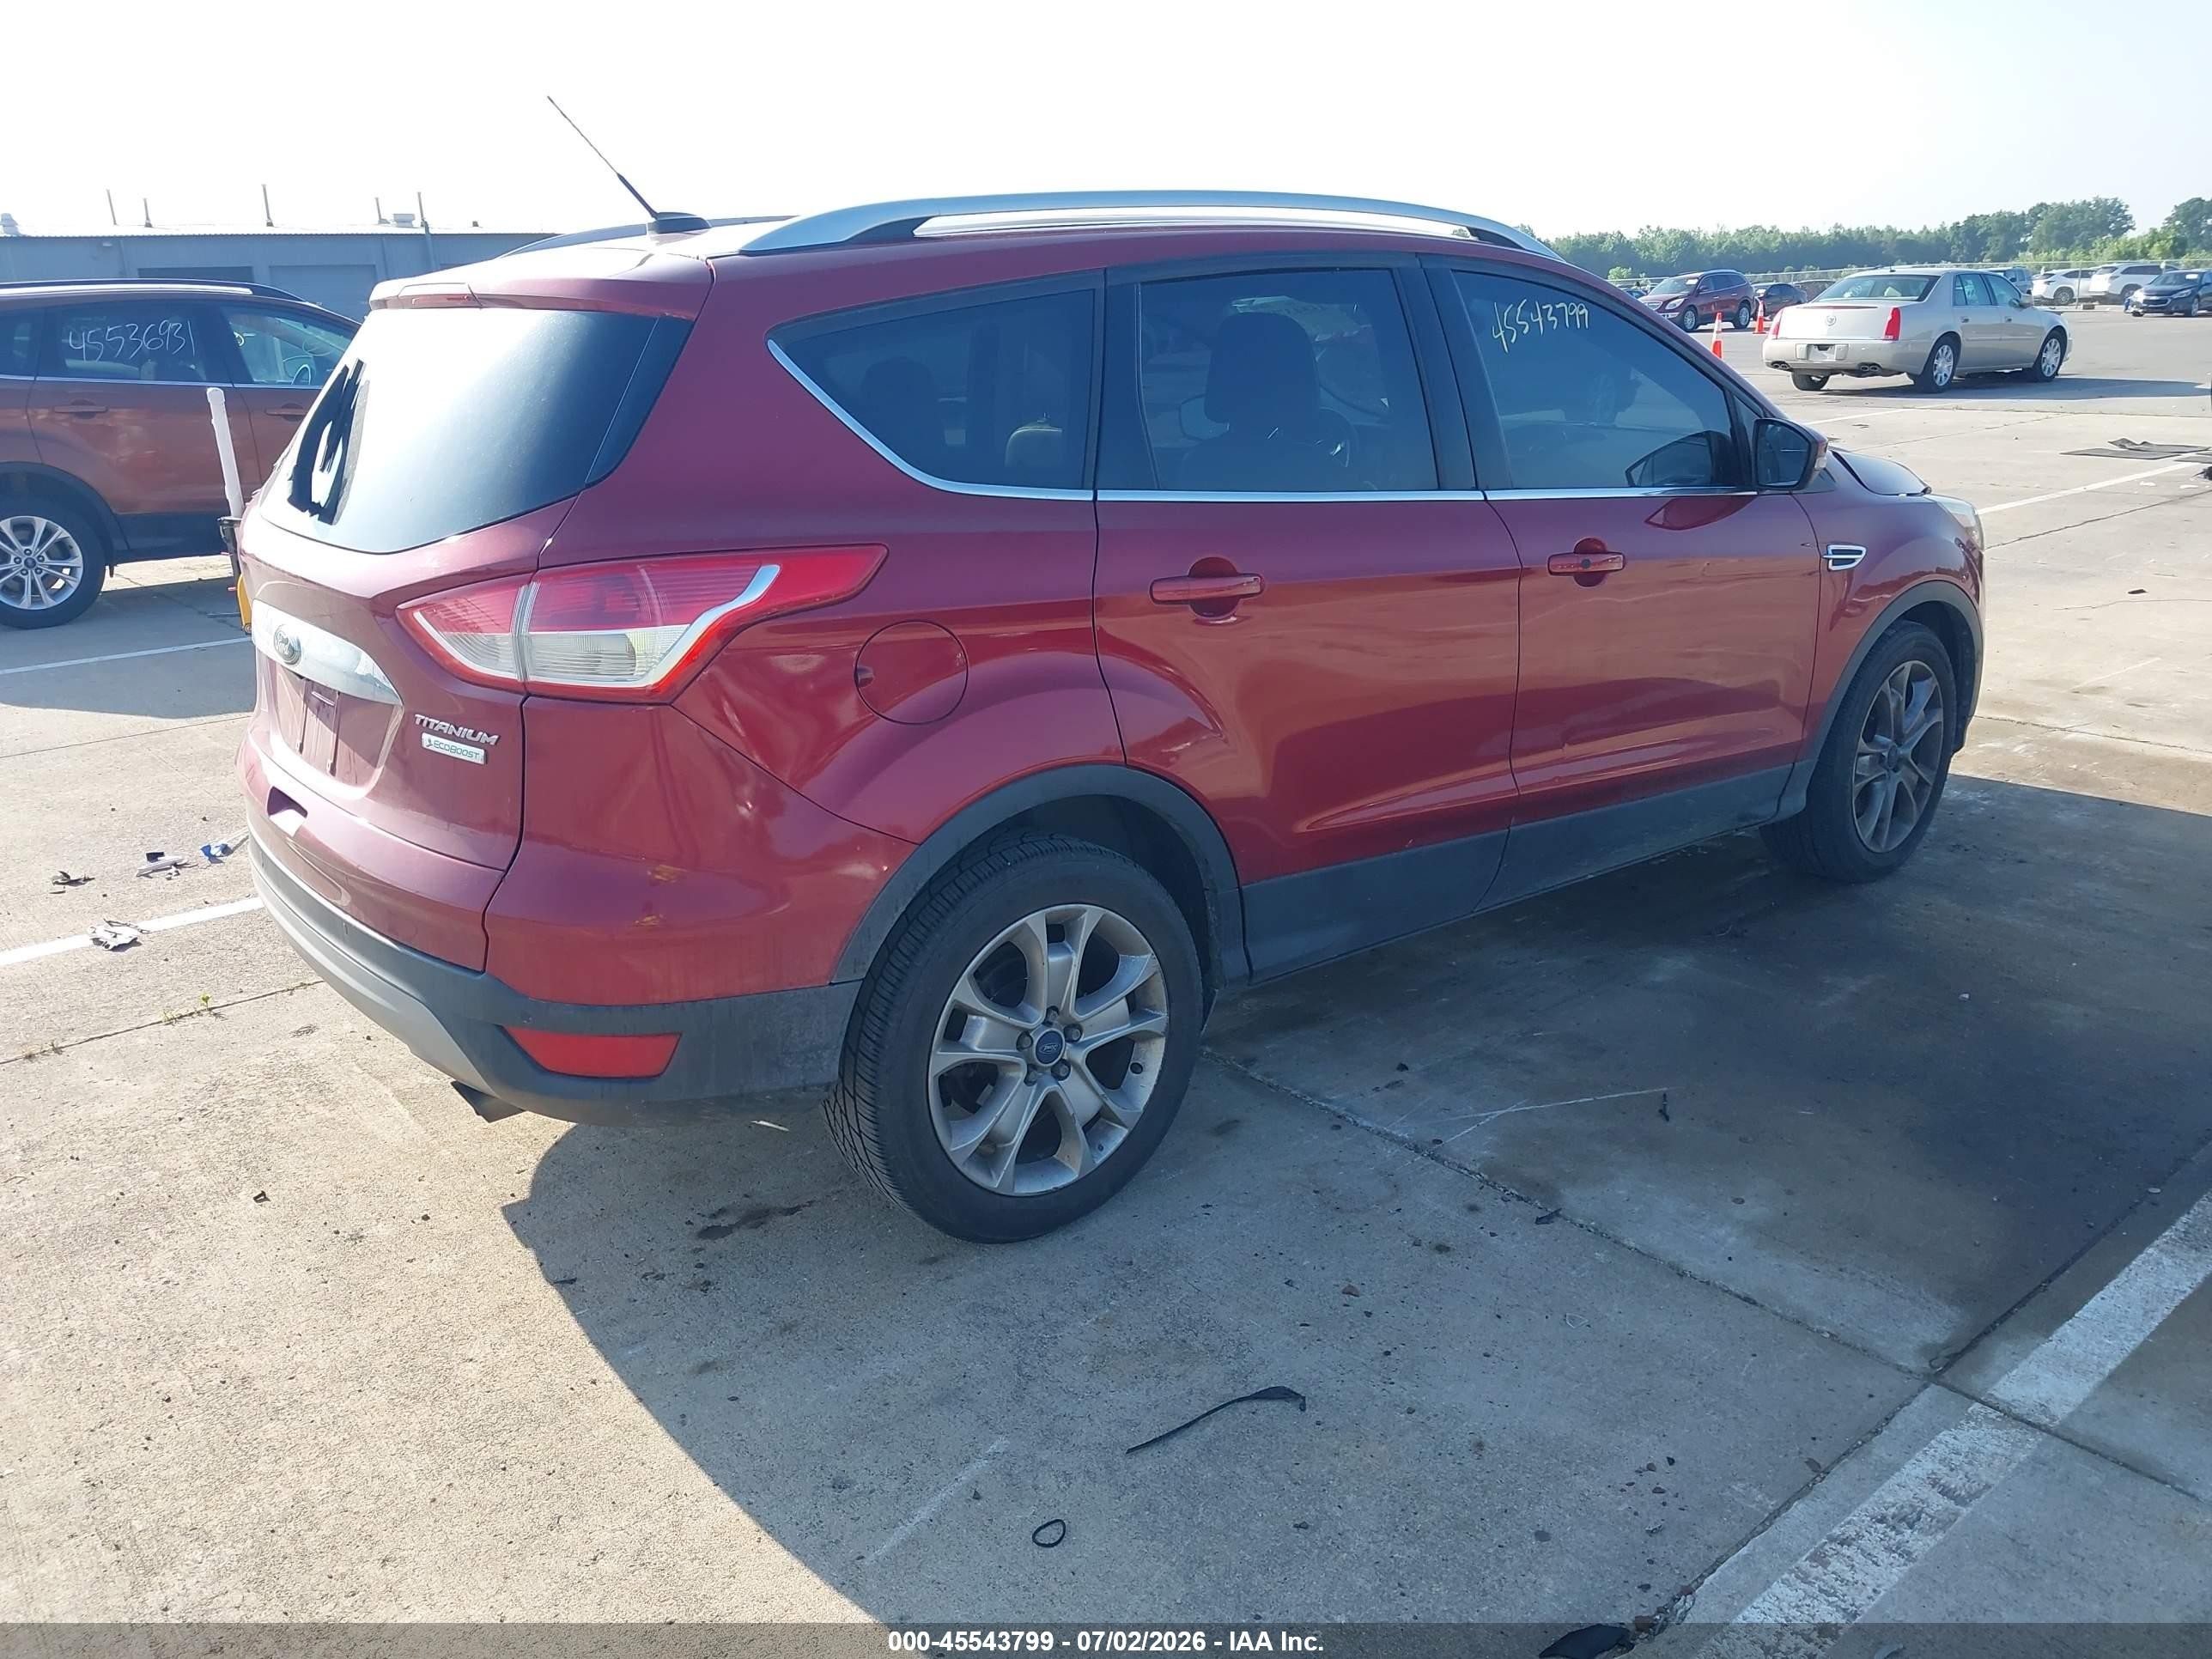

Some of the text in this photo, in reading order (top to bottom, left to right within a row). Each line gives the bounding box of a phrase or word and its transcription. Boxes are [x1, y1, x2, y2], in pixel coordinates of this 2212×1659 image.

[69, 319, 196, 362] 45536931
[1492, 299, 1589, 353] 45543799
[414, 714, 499, 746] TITANIUM
[433, 740, 480, 759] ECOBOOST
